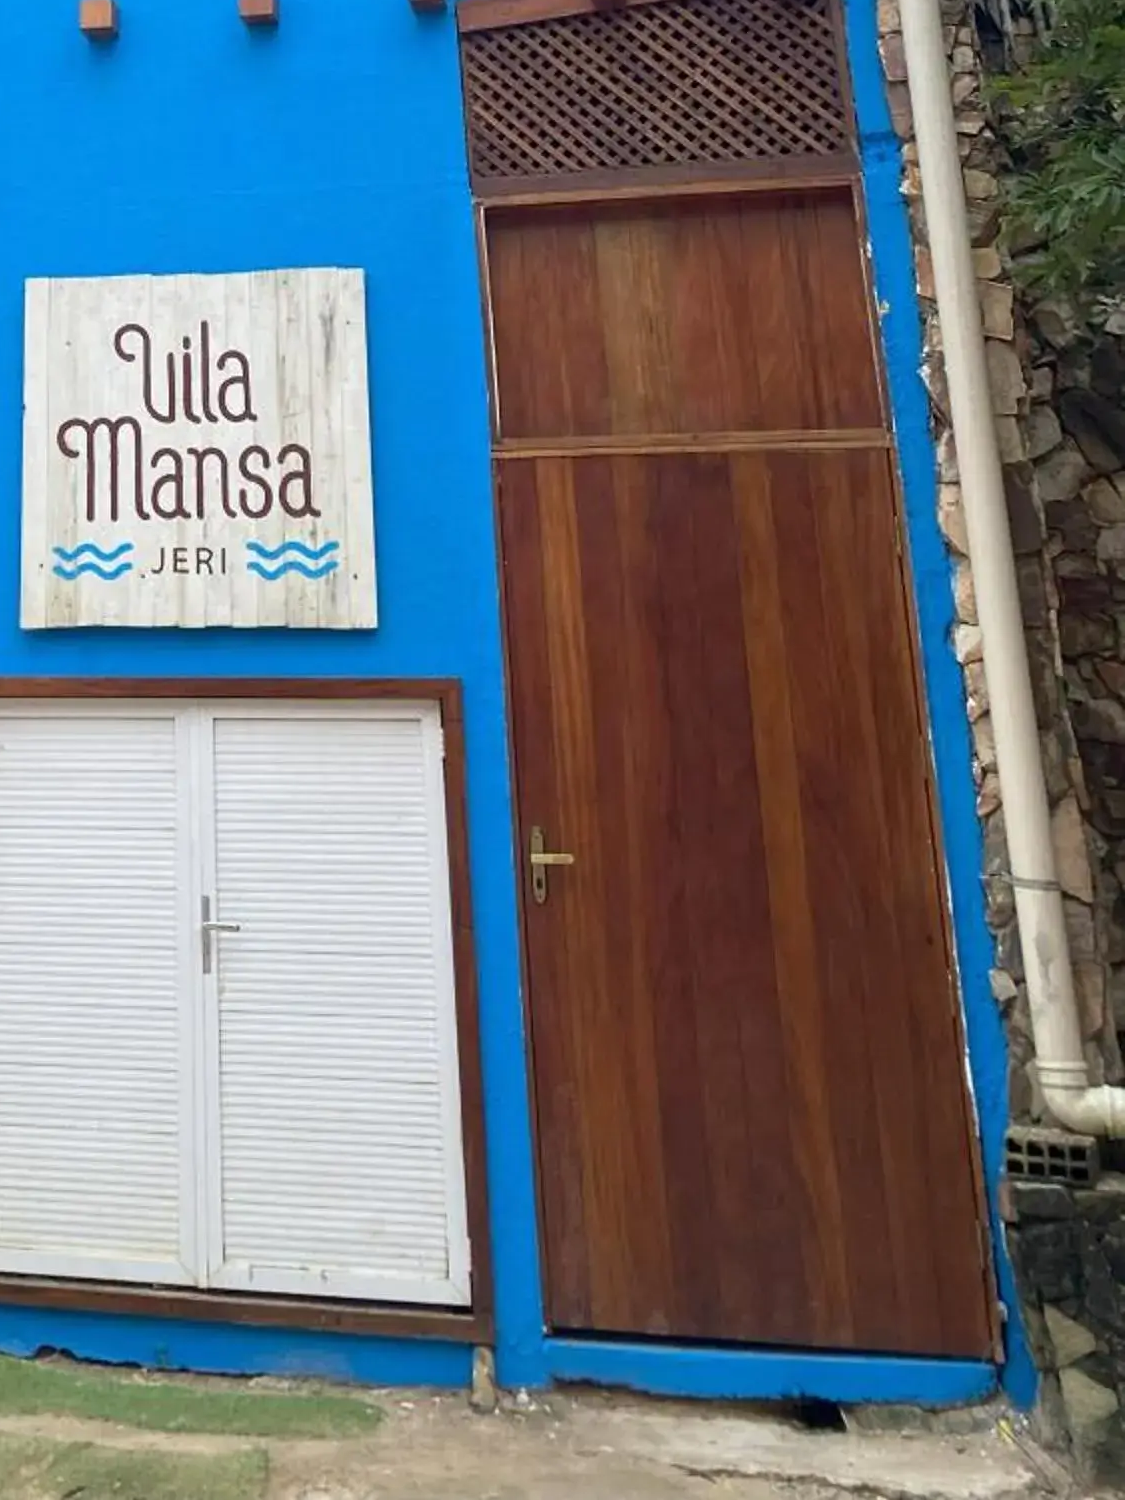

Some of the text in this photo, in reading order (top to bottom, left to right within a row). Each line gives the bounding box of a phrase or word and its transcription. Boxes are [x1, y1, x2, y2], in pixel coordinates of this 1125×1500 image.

[114, 320, 258, 424] Vila
[56, 416, 322, 522] Mansa
[150, 547, 227, 575] JERI
